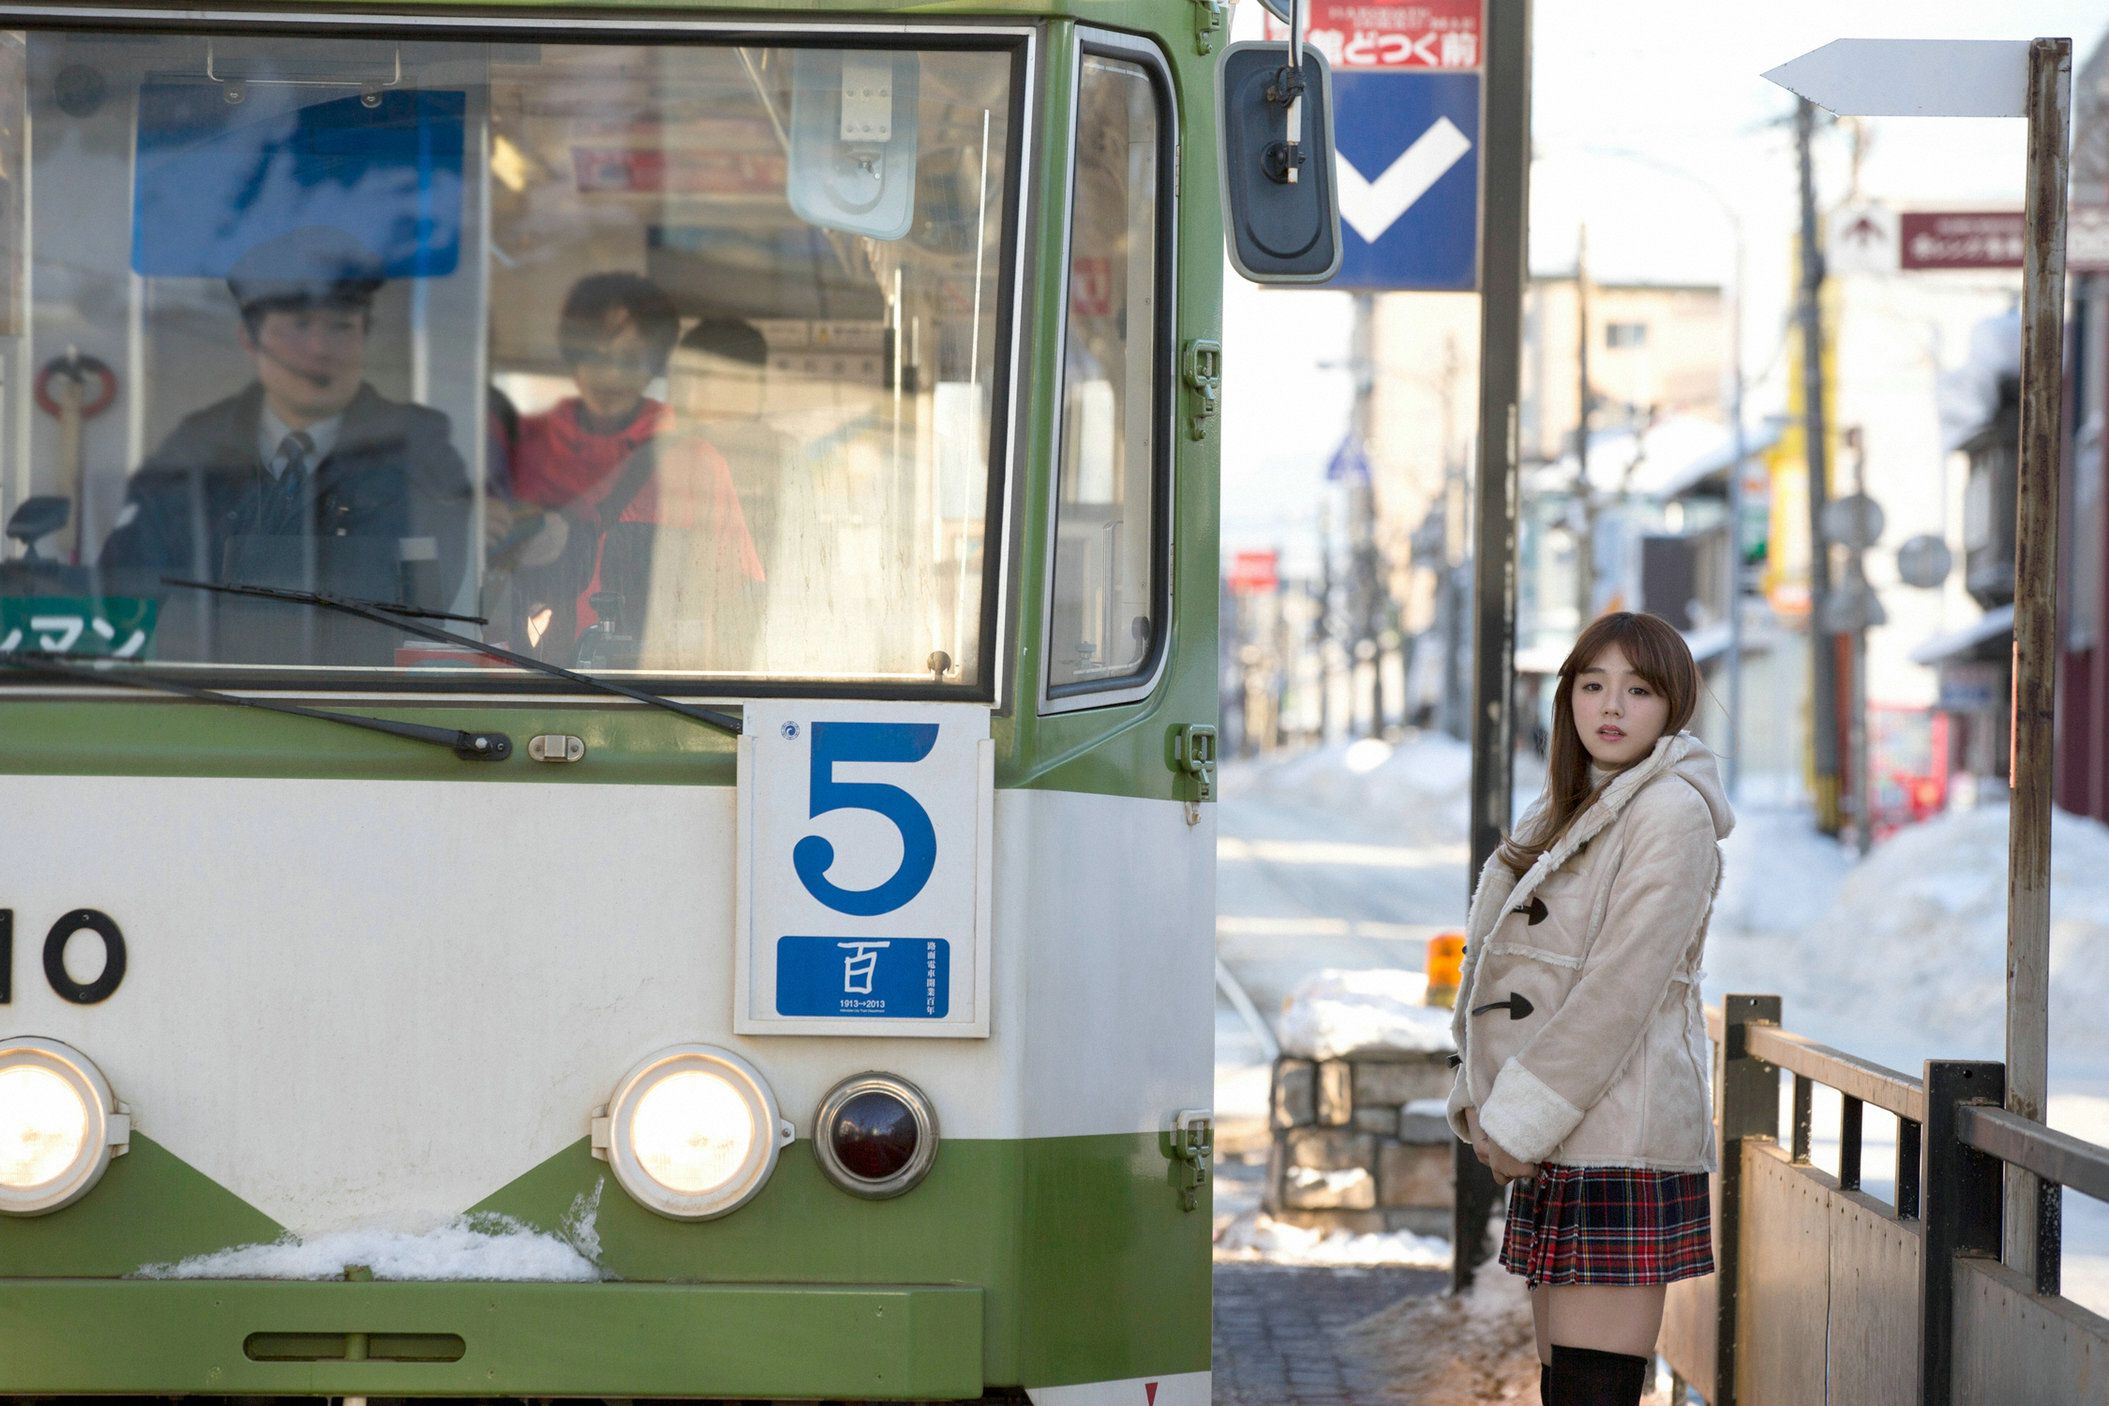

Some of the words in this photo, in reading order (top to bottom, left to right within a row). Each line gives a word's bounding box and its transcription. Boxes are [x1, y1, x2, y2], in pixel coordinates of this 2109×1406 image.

[1270, 30, 1478, 67] 館どつく前
[793, 721, 940, 917] 5
[837, 941, 891, 995] 百
